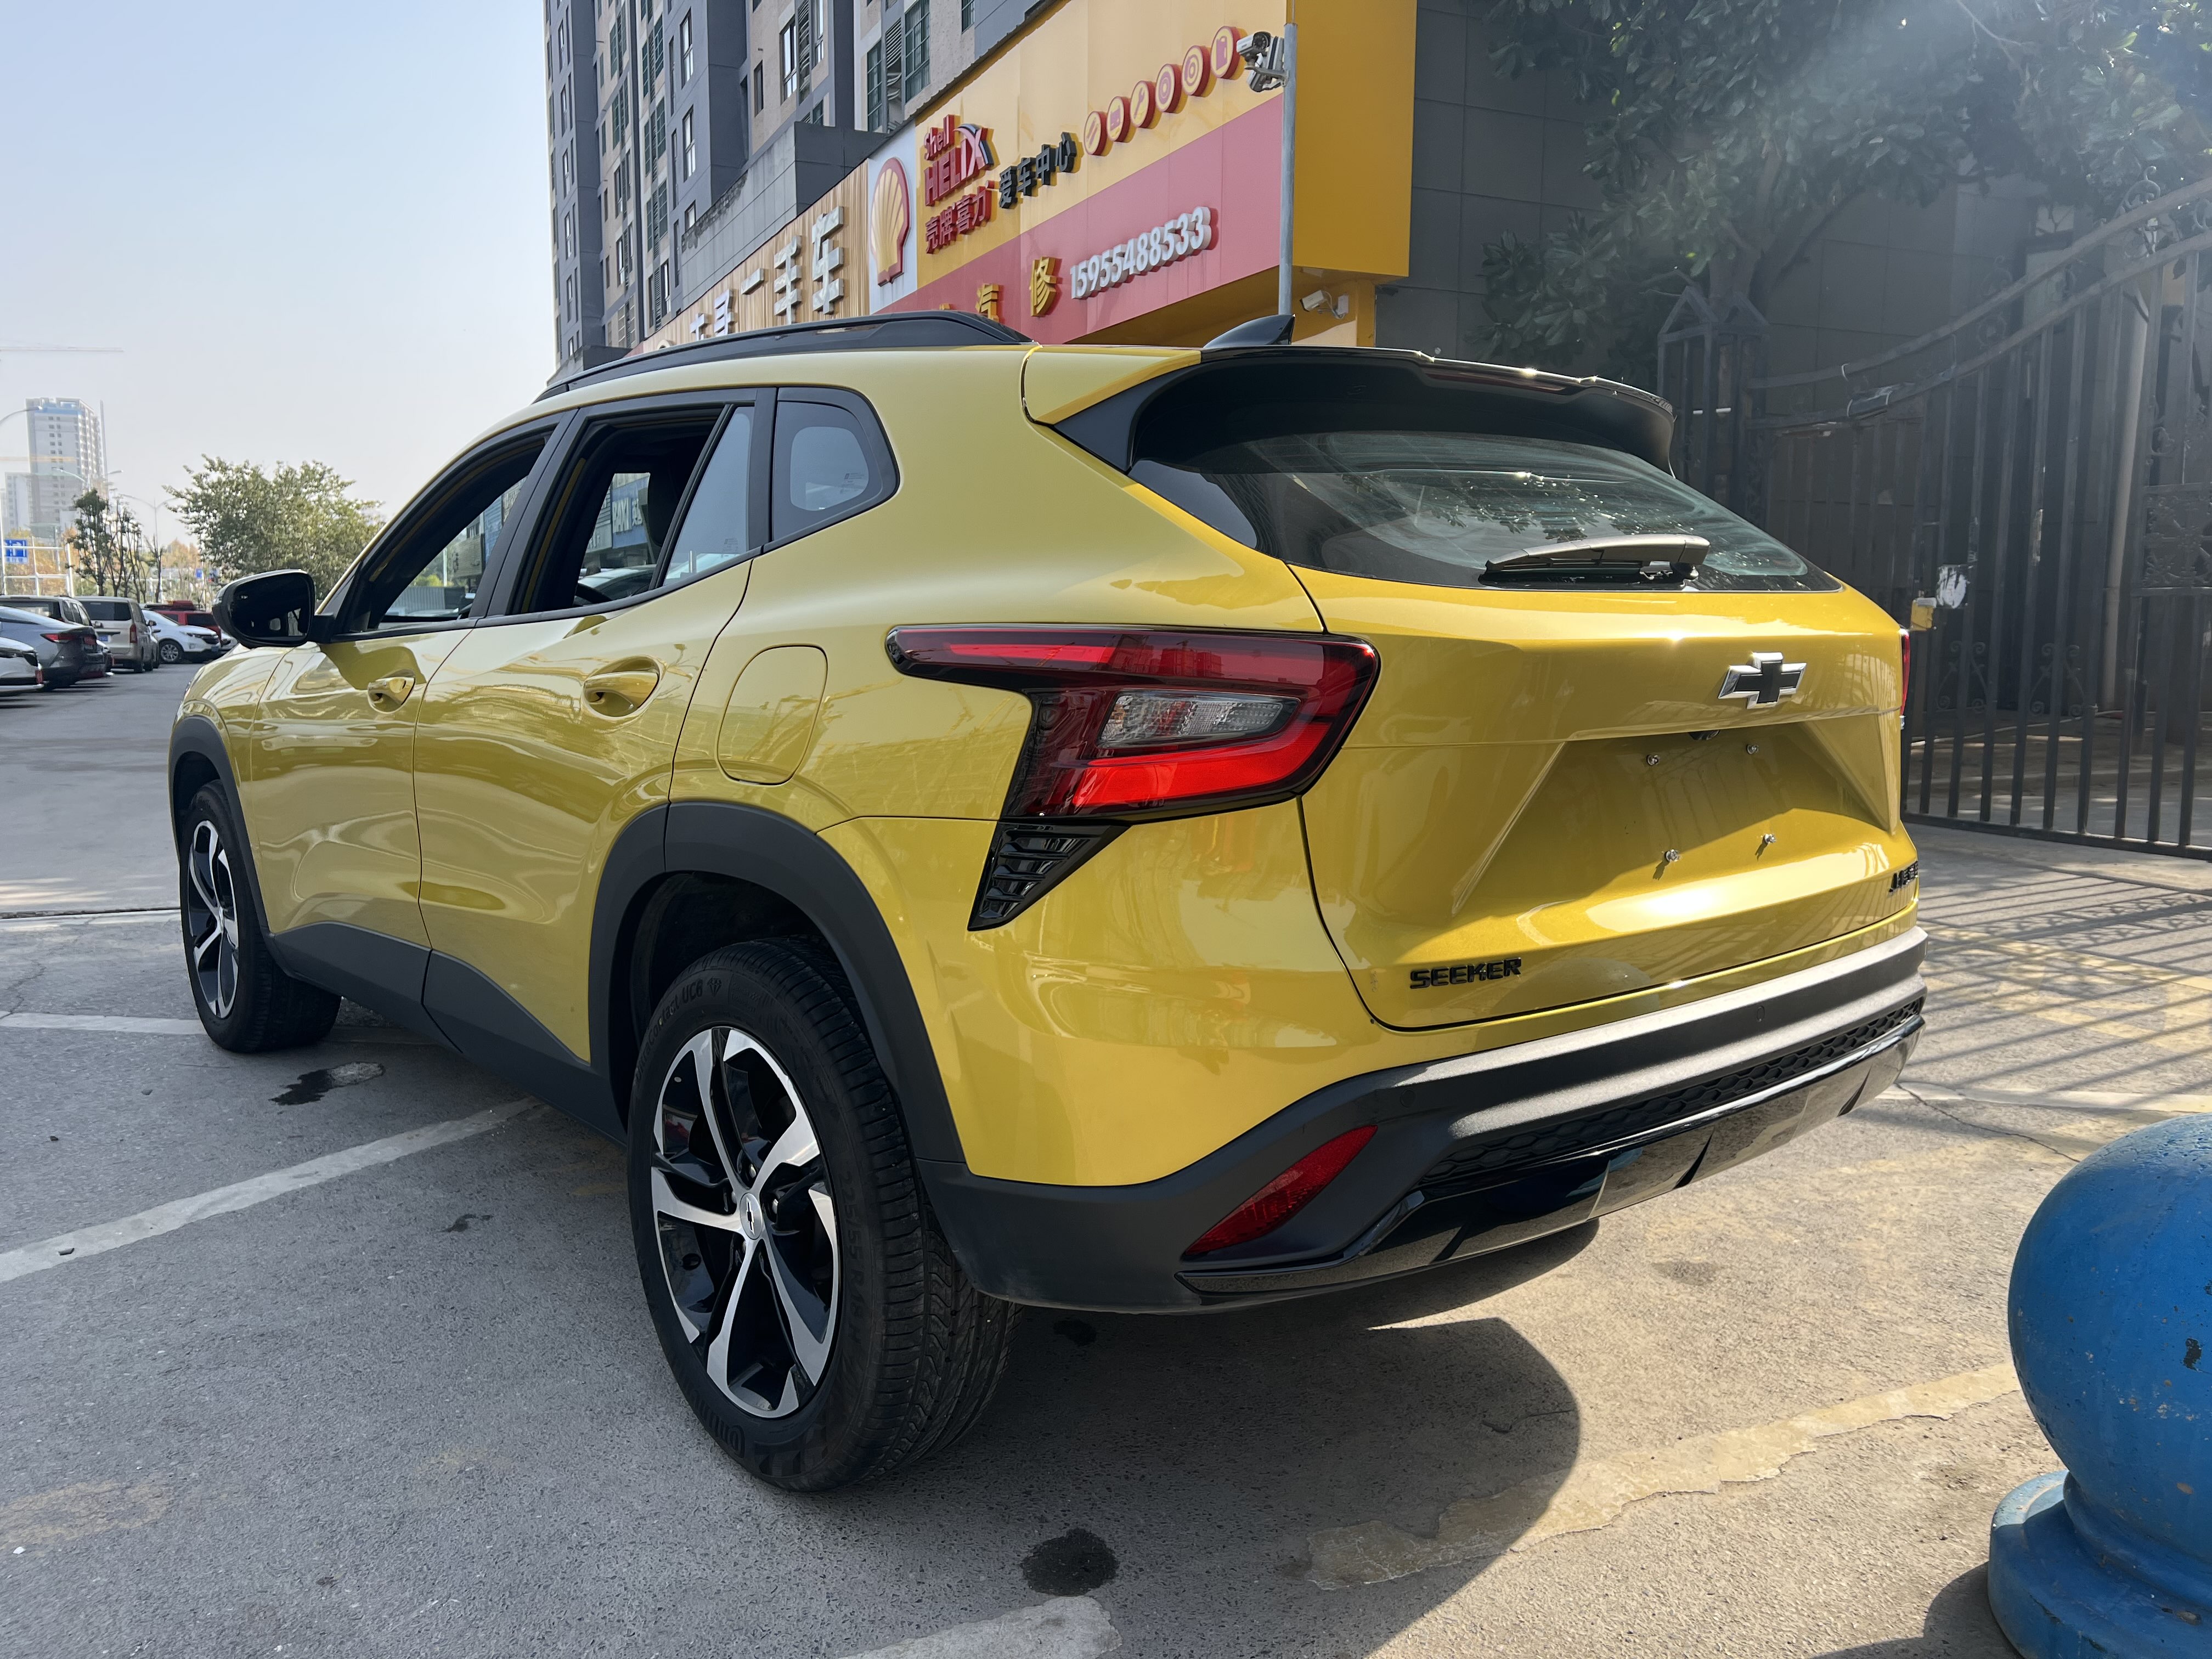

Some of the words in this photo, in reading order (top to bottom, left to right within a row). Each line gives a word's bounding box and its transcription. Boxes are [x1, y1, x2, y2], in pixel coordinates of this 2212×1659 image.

[924, 114, 955, 160] Shell
[924, 123, 994, 206] HELIX
[999, 131, 1076, 209] 爱车中心
[1070, 206, 1211, 300] 15955488533
[682, 979, 703, 1003] UC6
[1409, 957, 1522, 989] SEEKER
